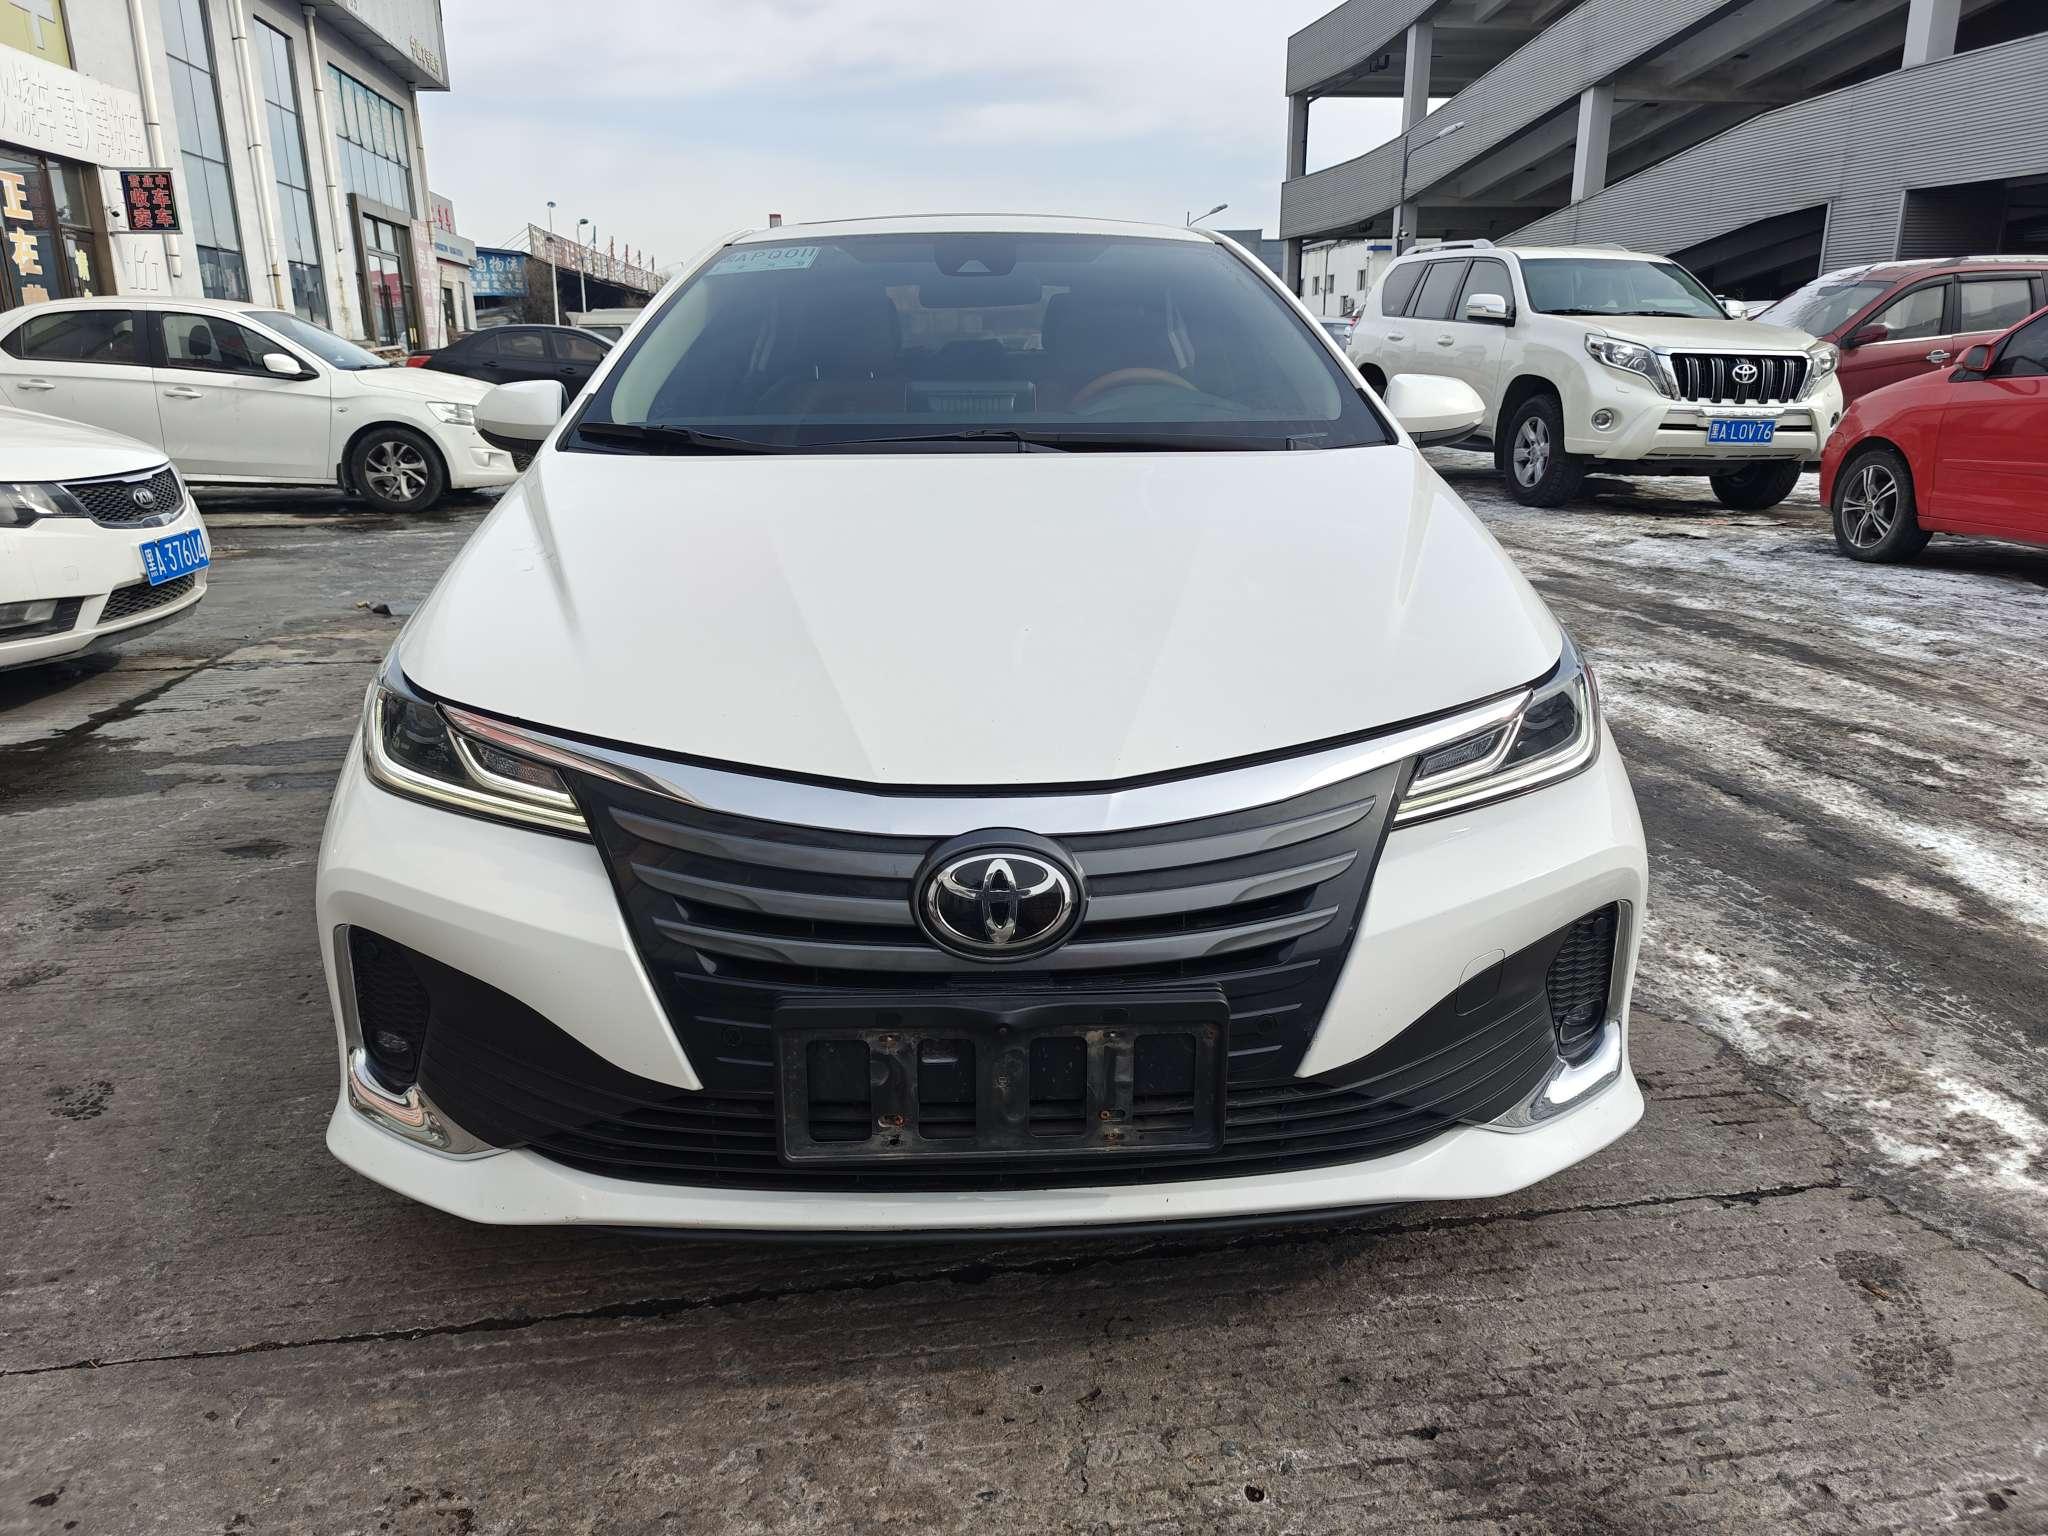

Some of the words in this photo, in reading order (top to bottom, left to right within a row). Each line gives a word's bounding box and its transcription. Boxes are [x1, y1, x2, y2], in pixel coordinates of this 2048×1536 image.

[127, 174, 168, 188] 营业中
[130, 188, 171, 207] 收车
[133, 207, 175, 228] 卖车
